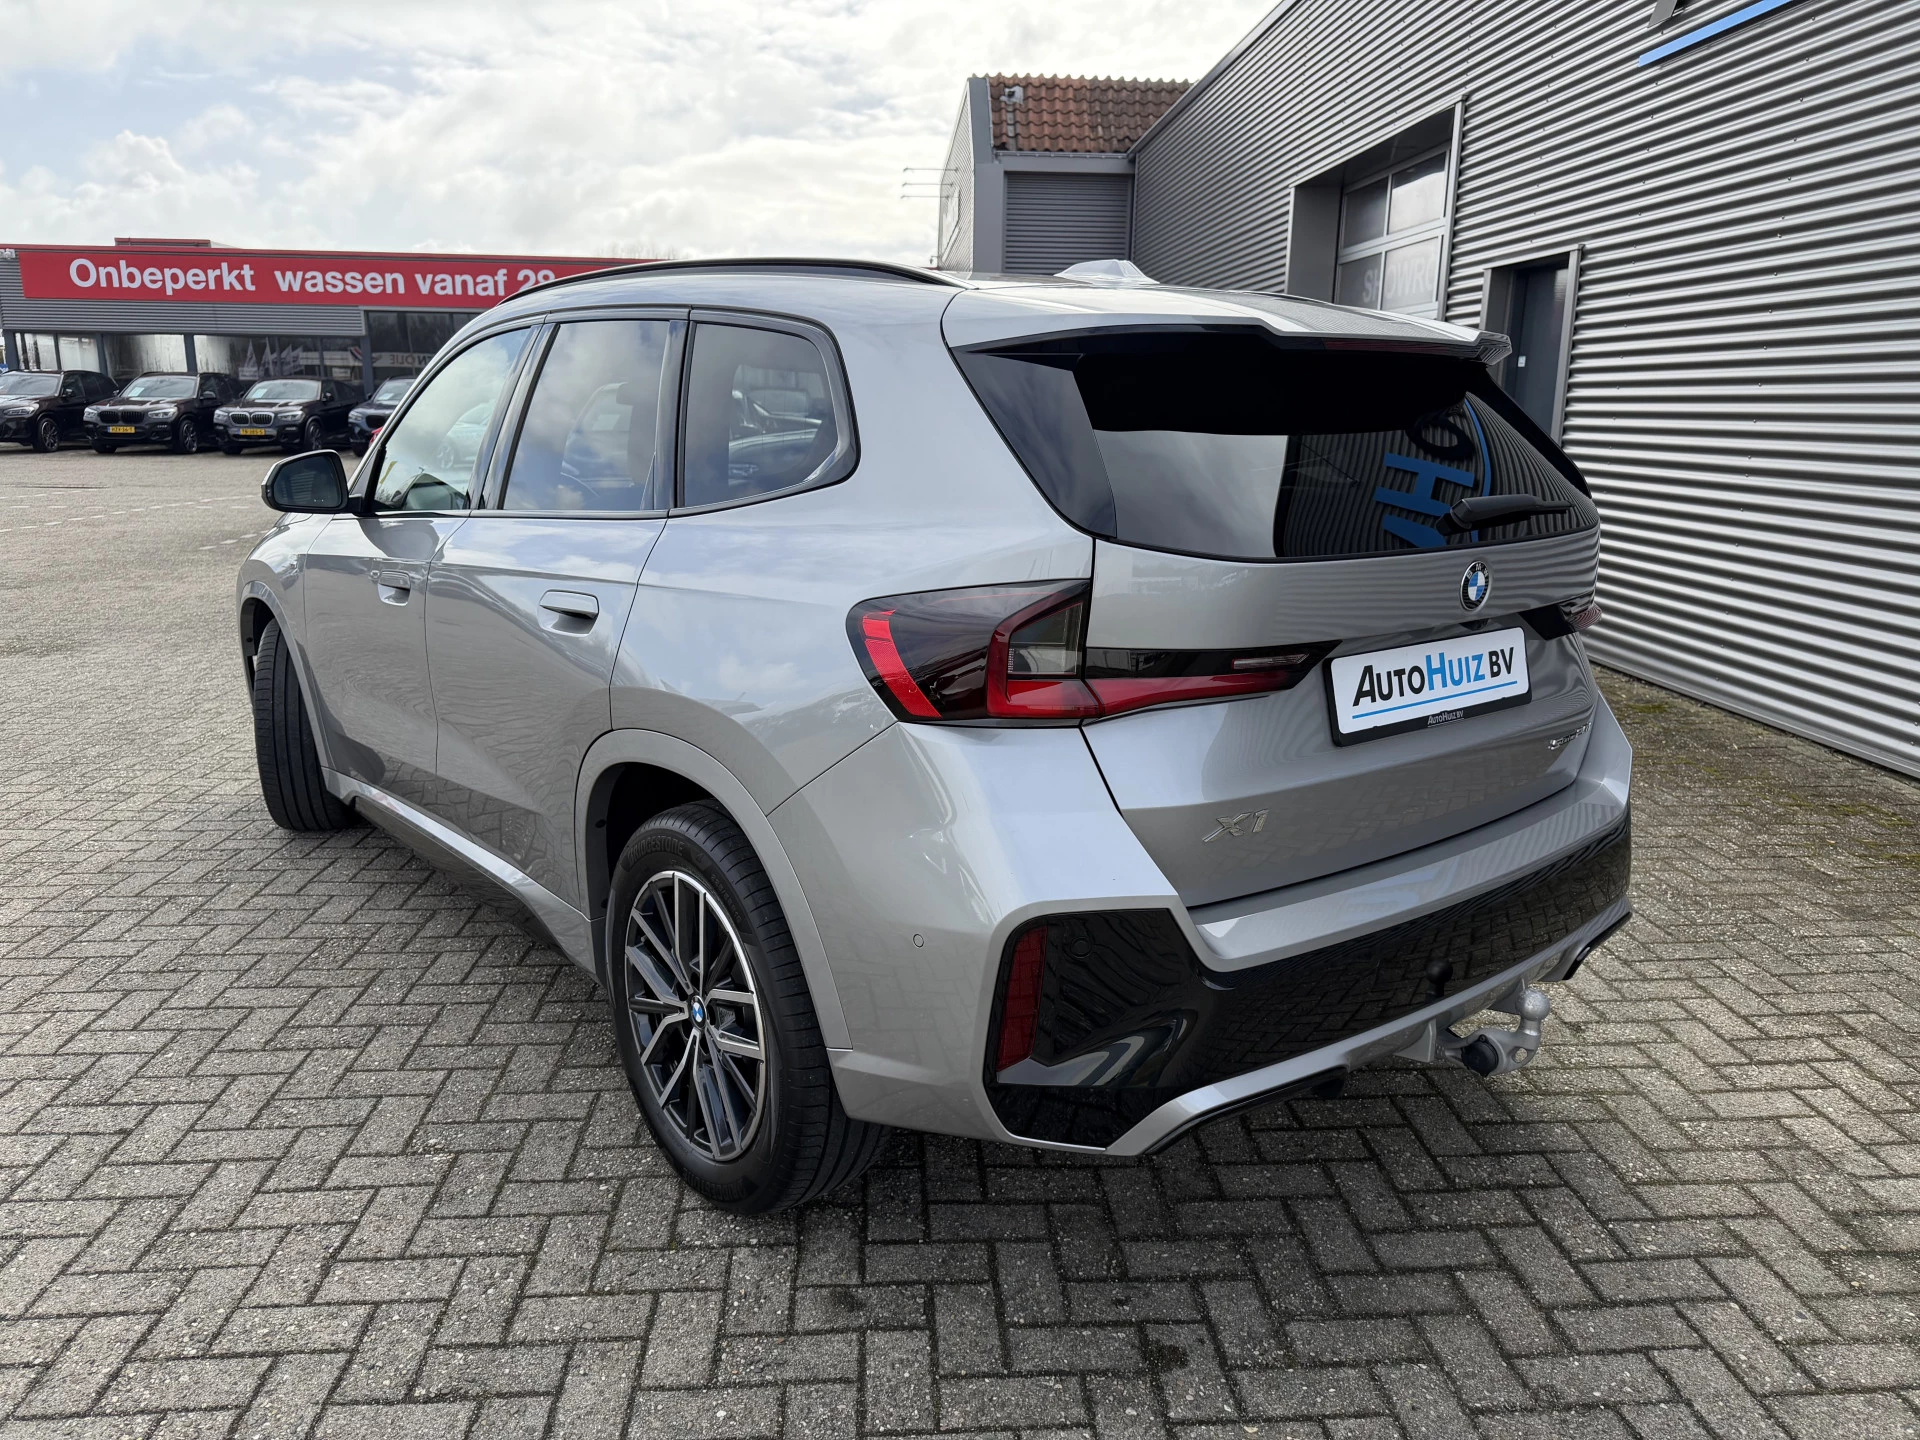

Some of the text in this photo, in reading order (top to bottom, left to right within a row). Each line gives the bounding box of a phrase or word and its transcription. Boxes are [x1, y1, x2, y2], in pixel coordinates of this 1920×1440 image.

[69, 258, 256, 295] Onbeperkt
[274, 270, 405, 294] wassen
[415, 269, 507, 296] vanaf
[1466, 563, 1489, 579] BMW
[1489, 647, 1515, 679] BV
[1202, 808, 1270, 843] X1
[627, 835, 686, 867] BRIDGESTONE
